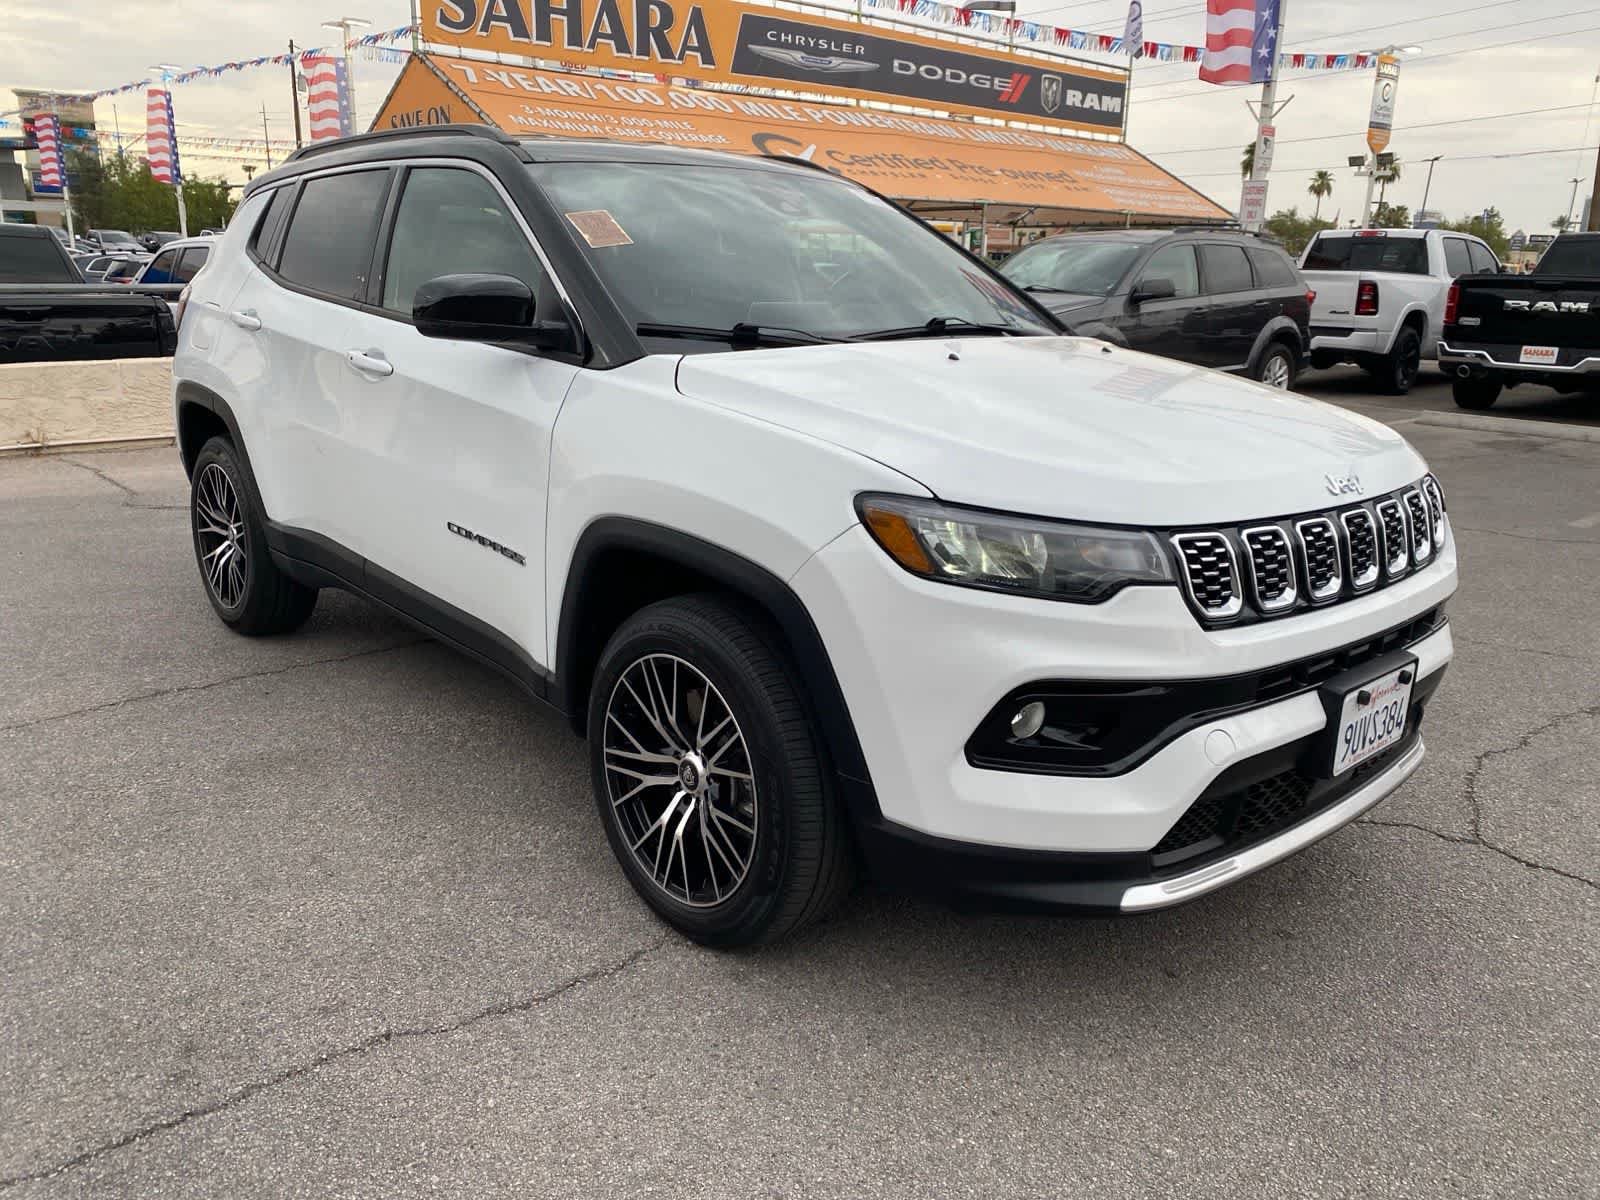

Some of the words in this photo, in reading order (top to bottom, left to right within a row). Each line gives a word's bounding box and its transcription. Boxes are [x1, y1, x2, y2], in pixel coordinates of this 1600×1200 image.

[435, 0, 716, 69] SAHARA
[766, 30, 866, 55] CHRYSLER
[892, 58, 1014, 92] DODGE
[1065, 88, 1122, 113] RAM
[390, 109, 424, 129] SAVE
[426, 103, 451, 125] ON
[507, 114, 601, 136] MAXIMUM
[605, 125, 657, 139] CARE
[732, 97, 809, 123] MILE
[803, 106, 965, 139] POWERTRAIN
[825, 149, 949, 173] Certified
[948, 159, 1079, 184] Pre-owned
[1502, 299, 1591, 313] RAM
[1324, 472, 1365, 496] Jeep
[446, 521, 527, 567] COMPASS
[1340, 695, 1405, 763] 9UVS384
